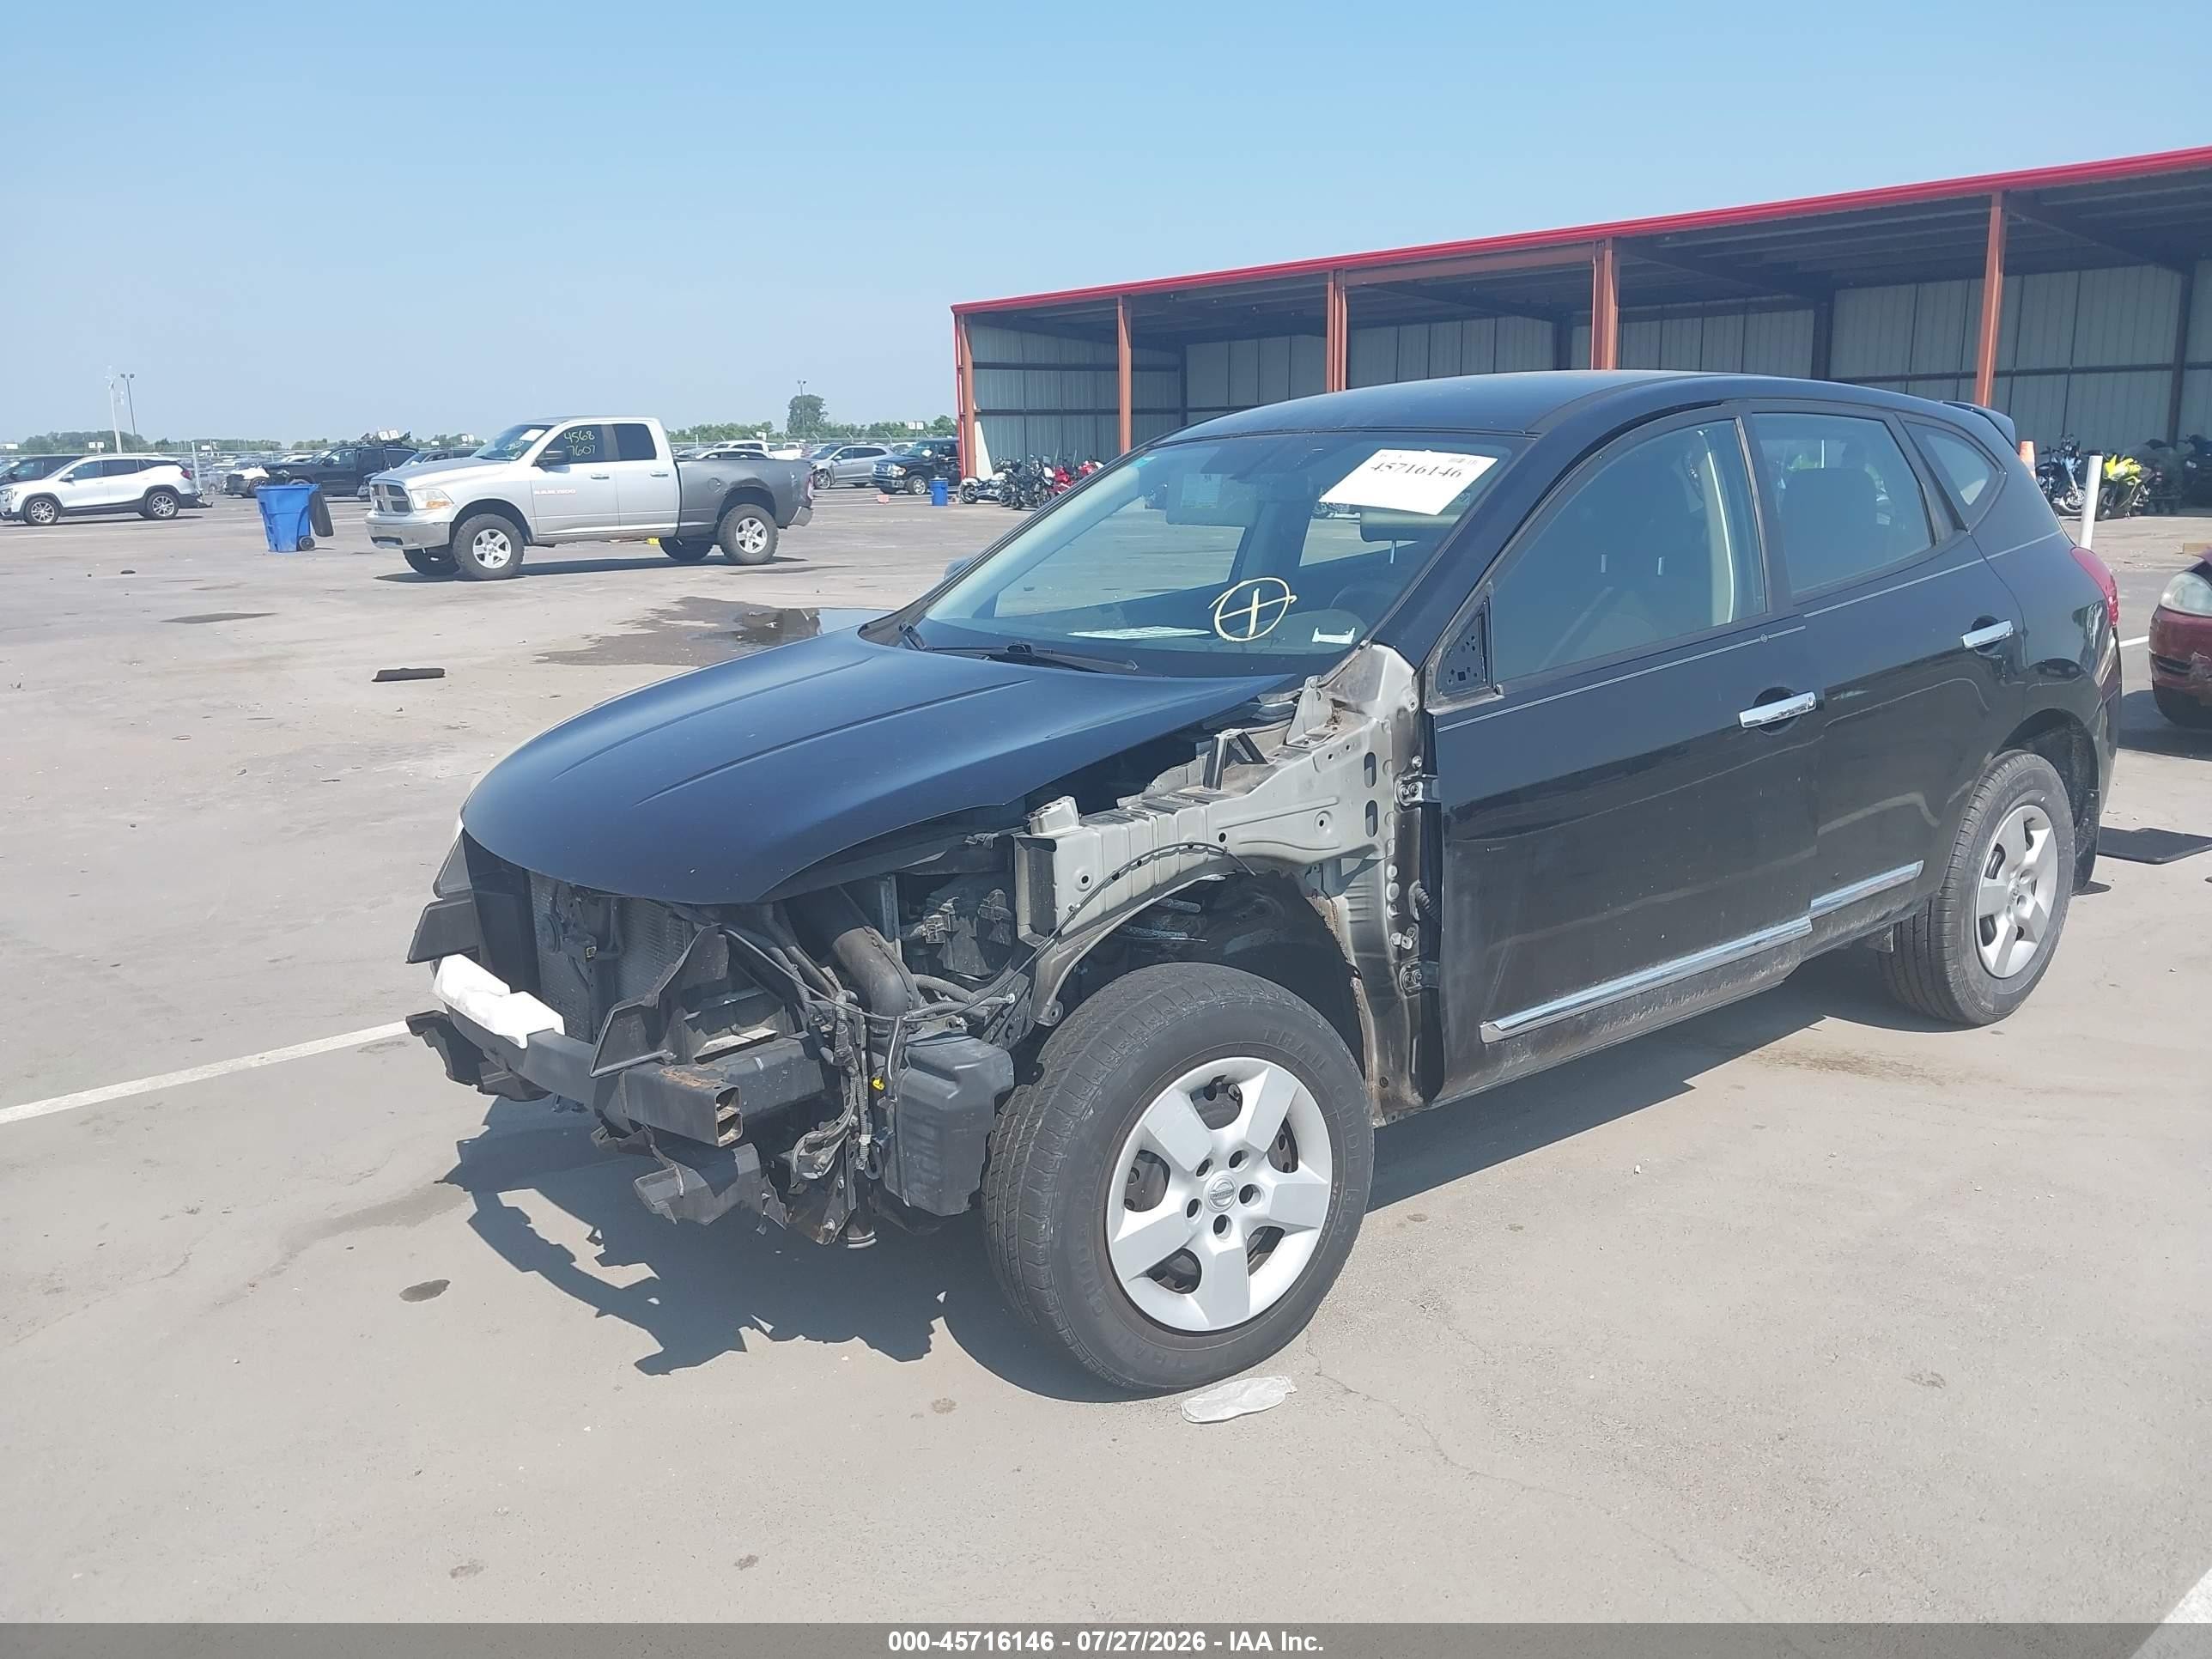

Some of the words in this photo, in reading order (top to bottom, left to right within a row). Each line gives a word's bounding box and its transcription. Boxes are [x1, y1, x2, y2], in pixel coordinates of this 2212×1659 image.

[564, 429, 596, 444] 4568
[567, 444, 596, 456] 7607
[1370, 461, 1464, 478] 45716146
